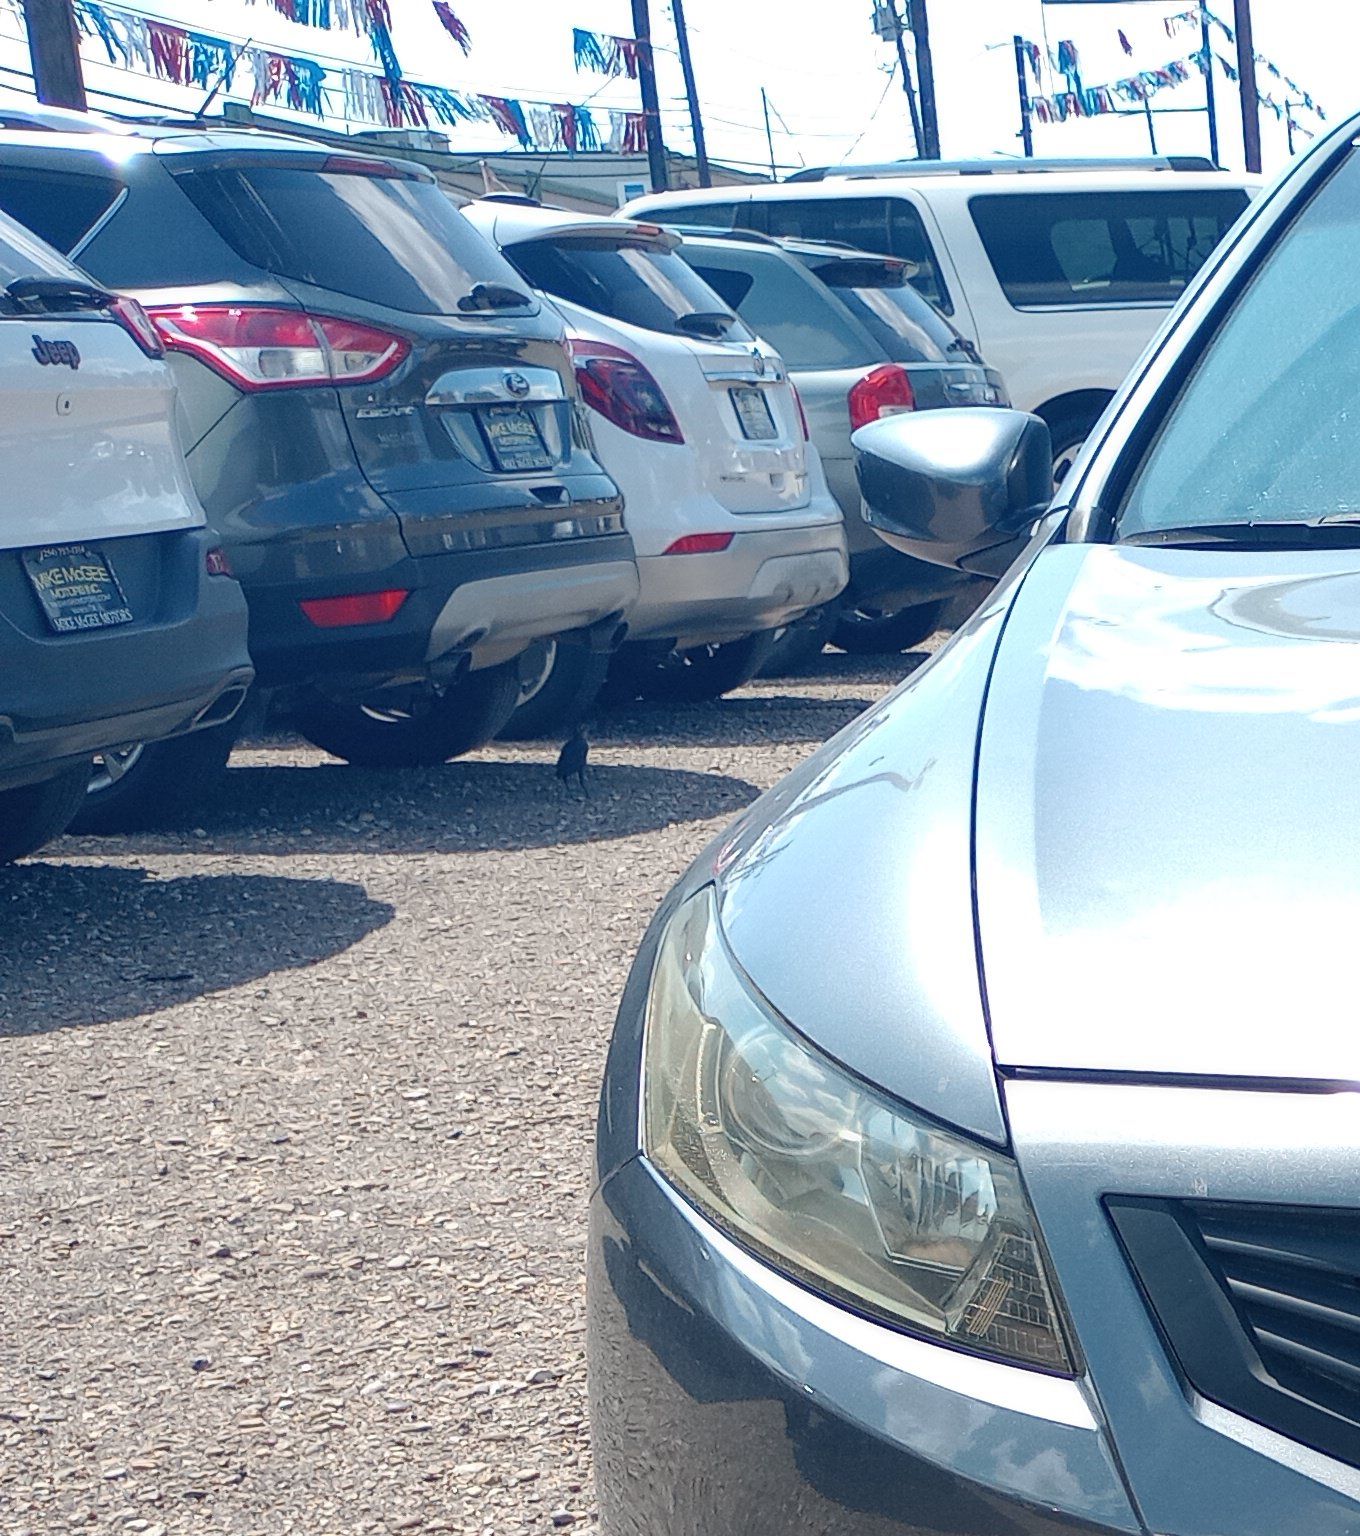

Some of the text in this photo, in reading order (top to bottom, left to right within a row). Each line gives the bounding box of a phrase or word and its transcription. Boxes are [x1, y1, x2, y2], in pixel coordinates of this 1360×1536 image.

[31, 334, 81, 370] Jeep
[356, 405, 415, 419] ESCAPE
[34, 568, 65, 591] MIKE
